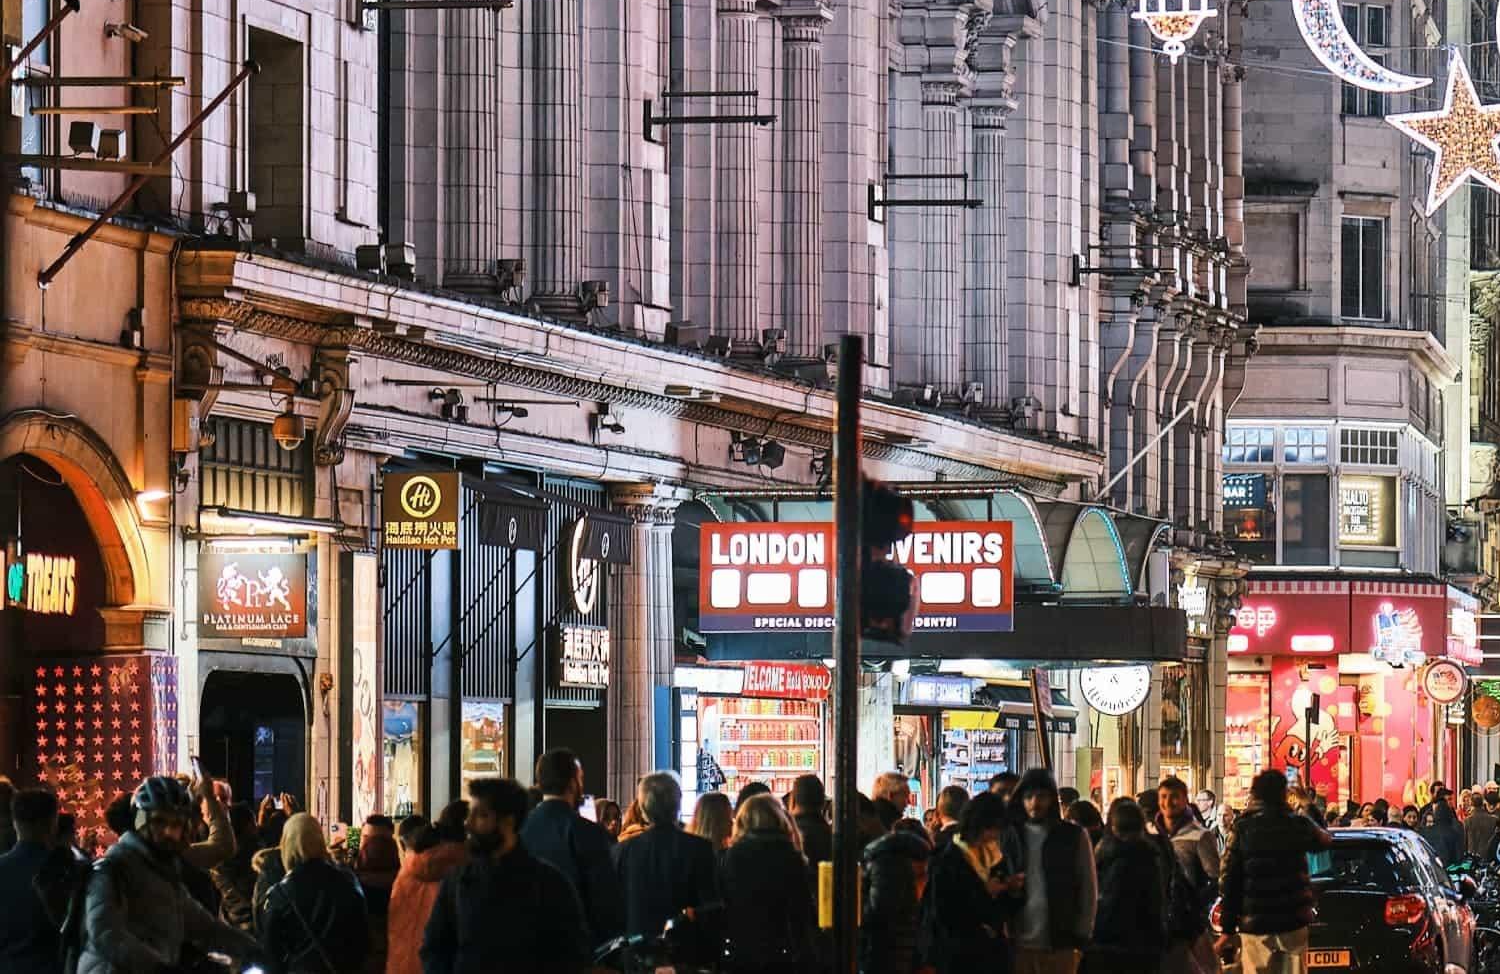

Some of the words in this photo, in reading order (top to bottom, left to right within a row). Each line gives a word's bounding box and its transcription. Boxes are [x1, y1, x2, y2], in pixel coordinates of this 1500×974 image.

[386, 534, 421, 545] Haidilao
[423, 534, 439, 545] Hot
[440, 534, 456, 545] Pot
[711, 533, 825, 566] LONDON
[26, 553, 76, 617] TREATS
[203, 613, 265, 625] PLATINUM
[270, 613, 300, 624] LACE
[755, 617, 801, 628] SPECIAL
